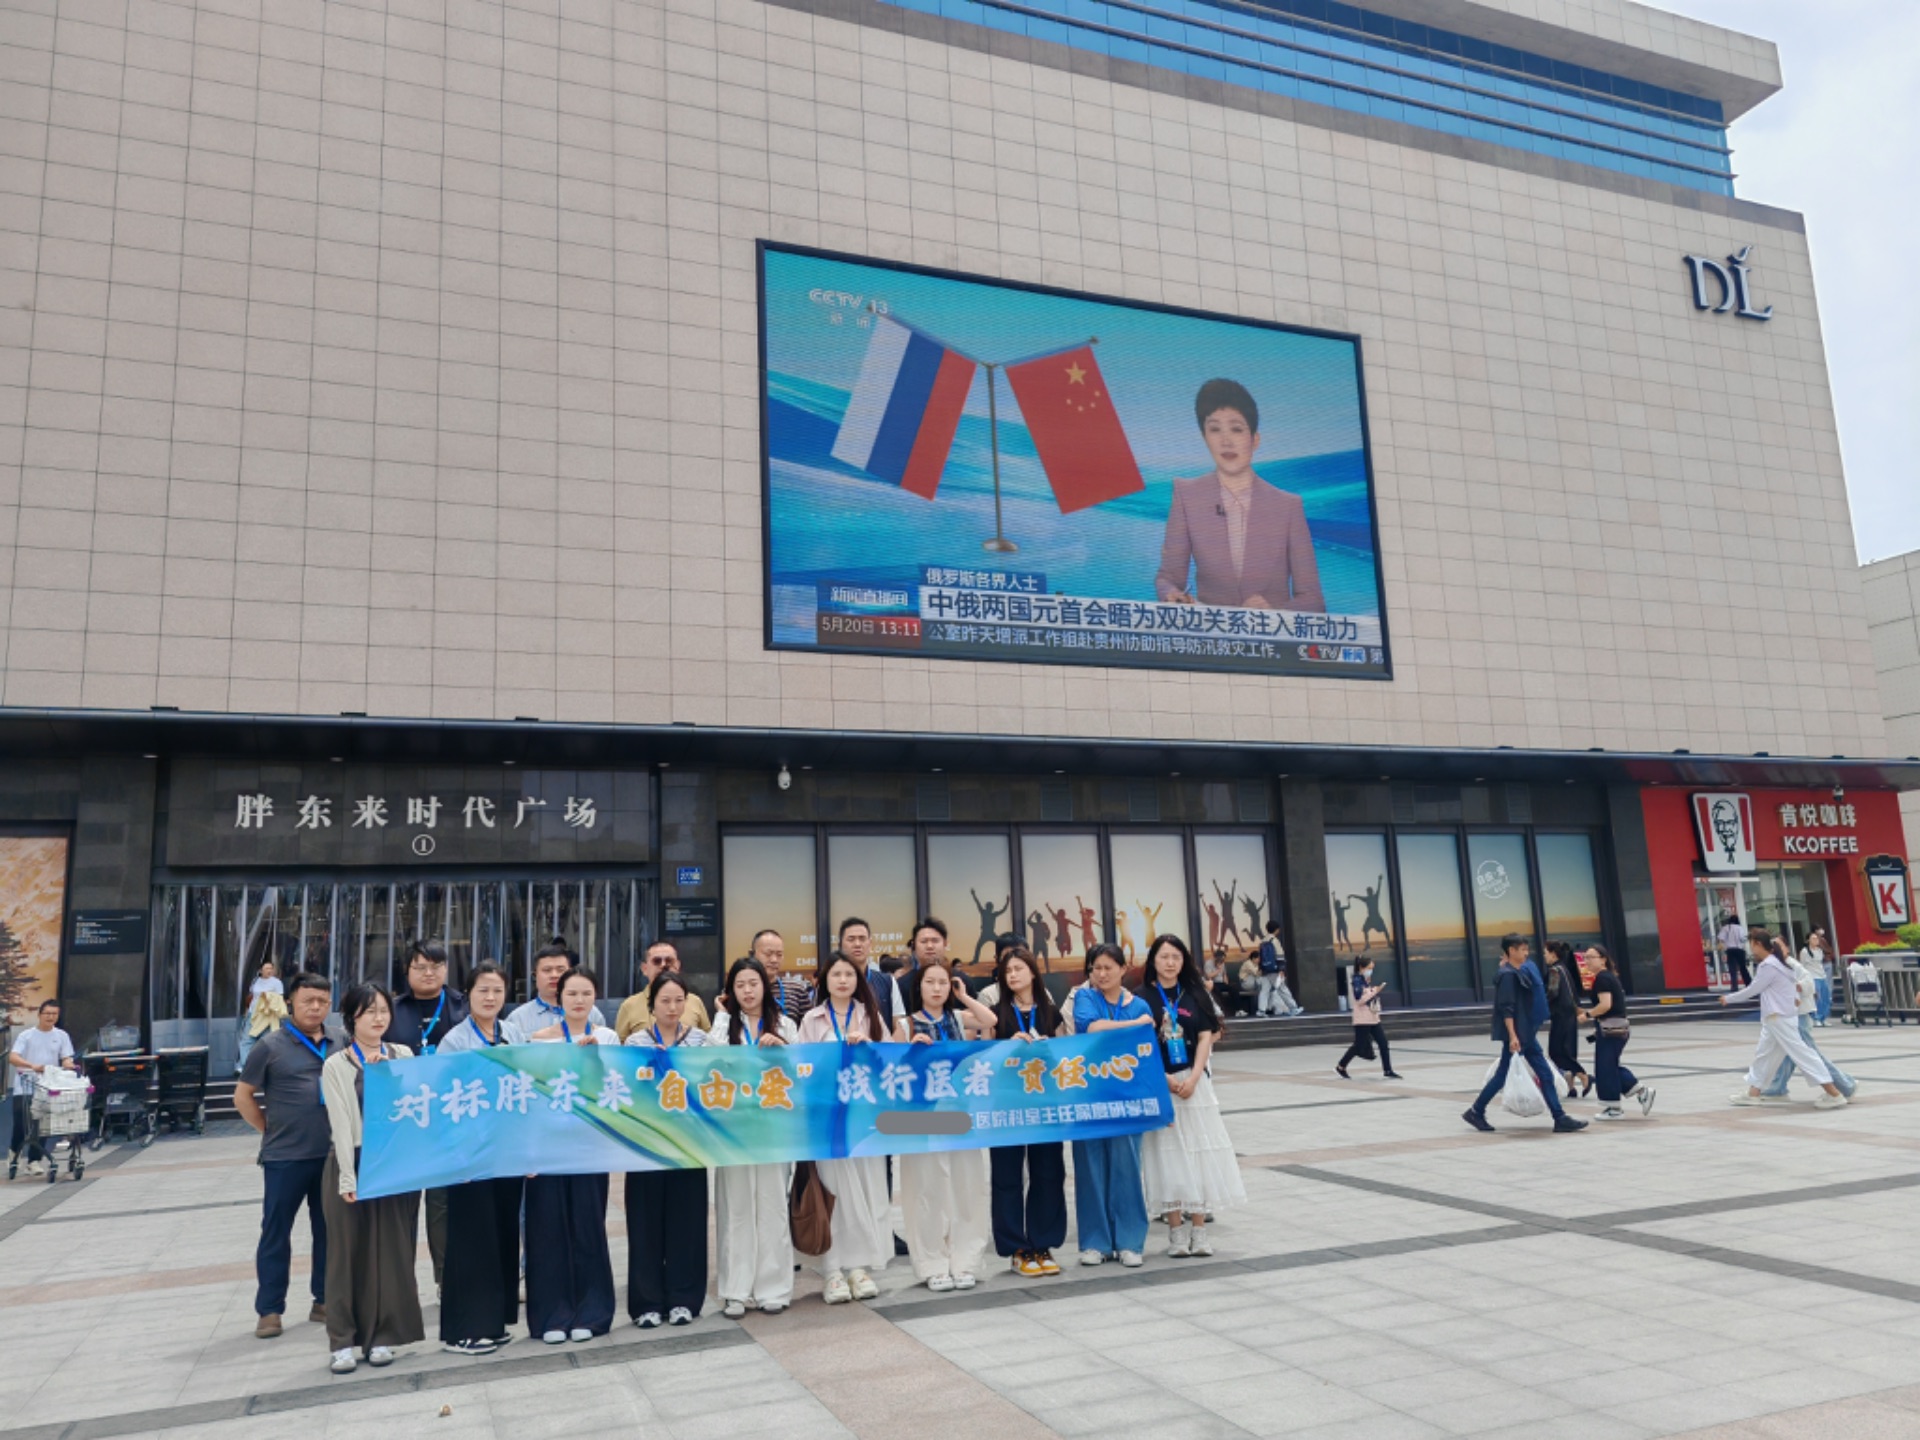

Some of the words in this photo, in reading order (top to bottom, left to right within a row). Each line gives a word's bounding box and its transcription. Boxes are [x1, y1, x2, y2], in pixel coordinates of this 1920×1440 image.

[809, 288, 863, 308] CCTV
[926, 567, 1038, 592] 俄罗斯各界人士
[822, 616, 874, 634] 5月20日
[881, 621, 920, 637] 13:11
[928, 588, 1357, 641] 中俄两国元首会晤为双边关系注入新动力
[1297, 644, 1339, 660] CCTV
[234, 793, 598, 830] 胖东来时代广场
[1779, 803, 1858, 828] 肯悦咖啡
[1784, 836, 1859, 854] KCOFFEE
[1877, 882, 1903, 915] K
[970, 1097, 1160, 1130] 医院科室主任深度研学团
